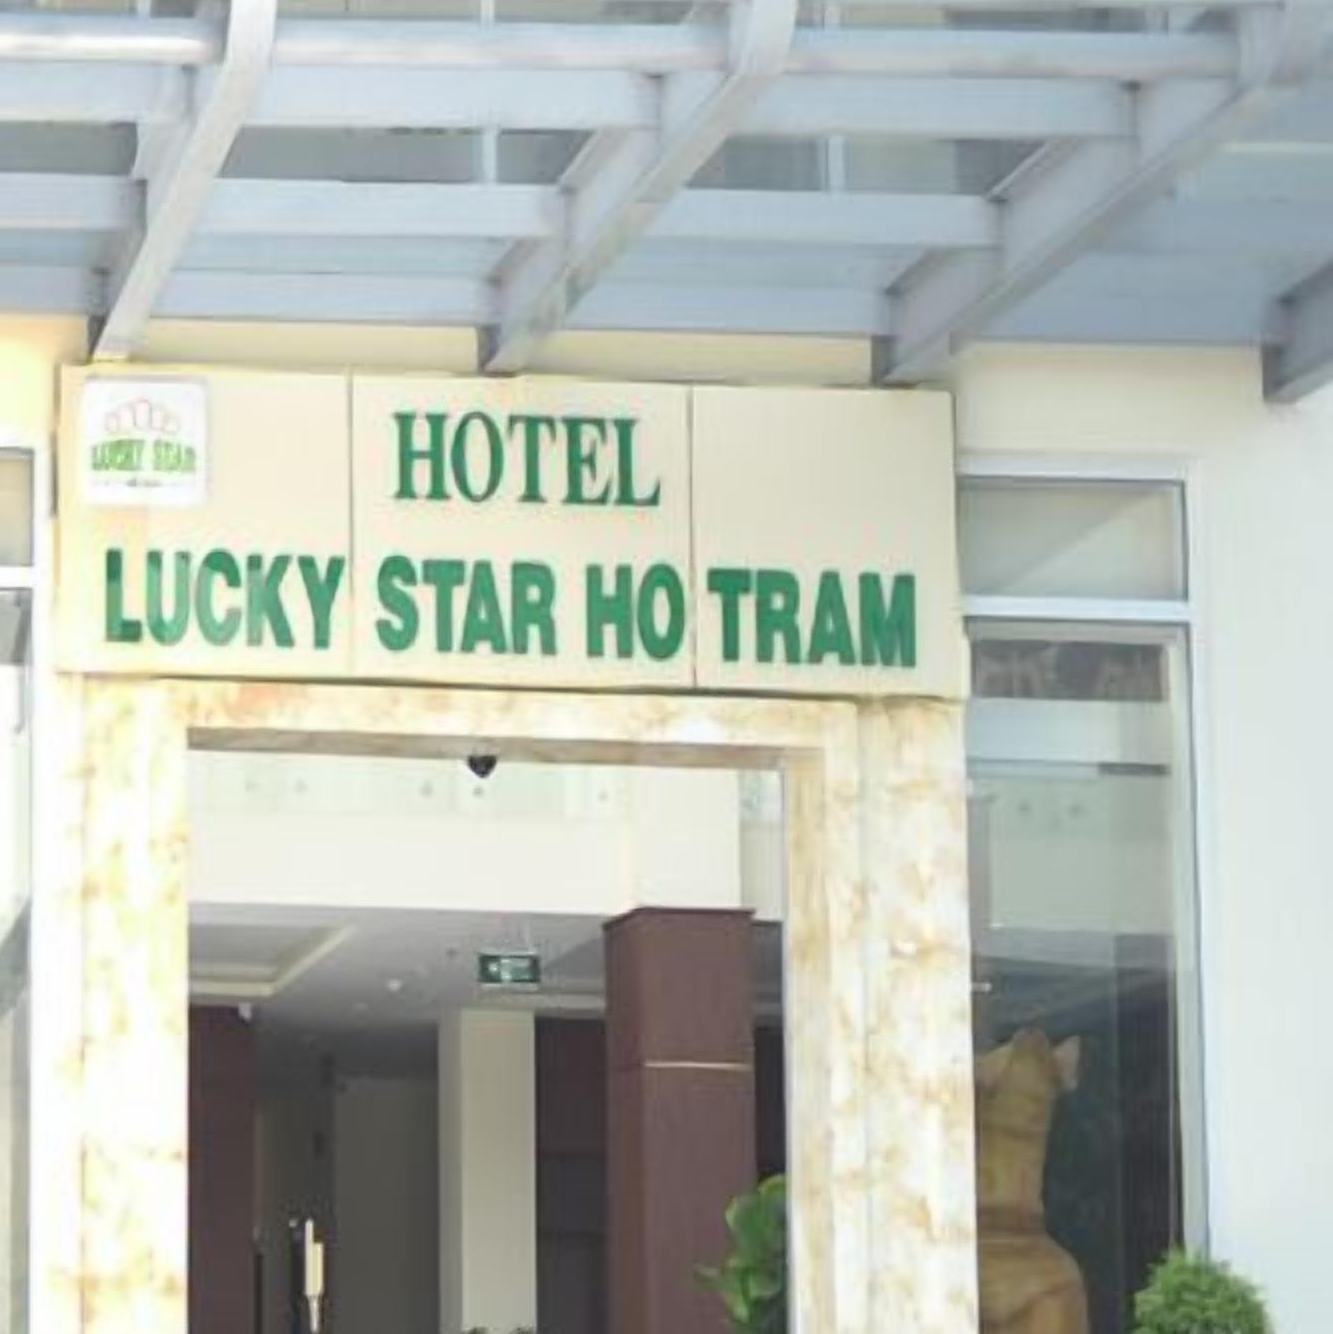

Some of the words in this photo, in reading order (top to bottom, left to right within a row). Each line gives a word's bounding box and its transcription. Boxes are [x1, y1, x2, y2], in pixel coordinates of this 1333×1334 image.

[396, 412, 661, 507] HOTEL
[104, 548, 346, 649] LUCKY
[375, 554, 557, 656] STAR
[585, 562, 687, 661] HO
[706, 567, 917, 669] TRAM
